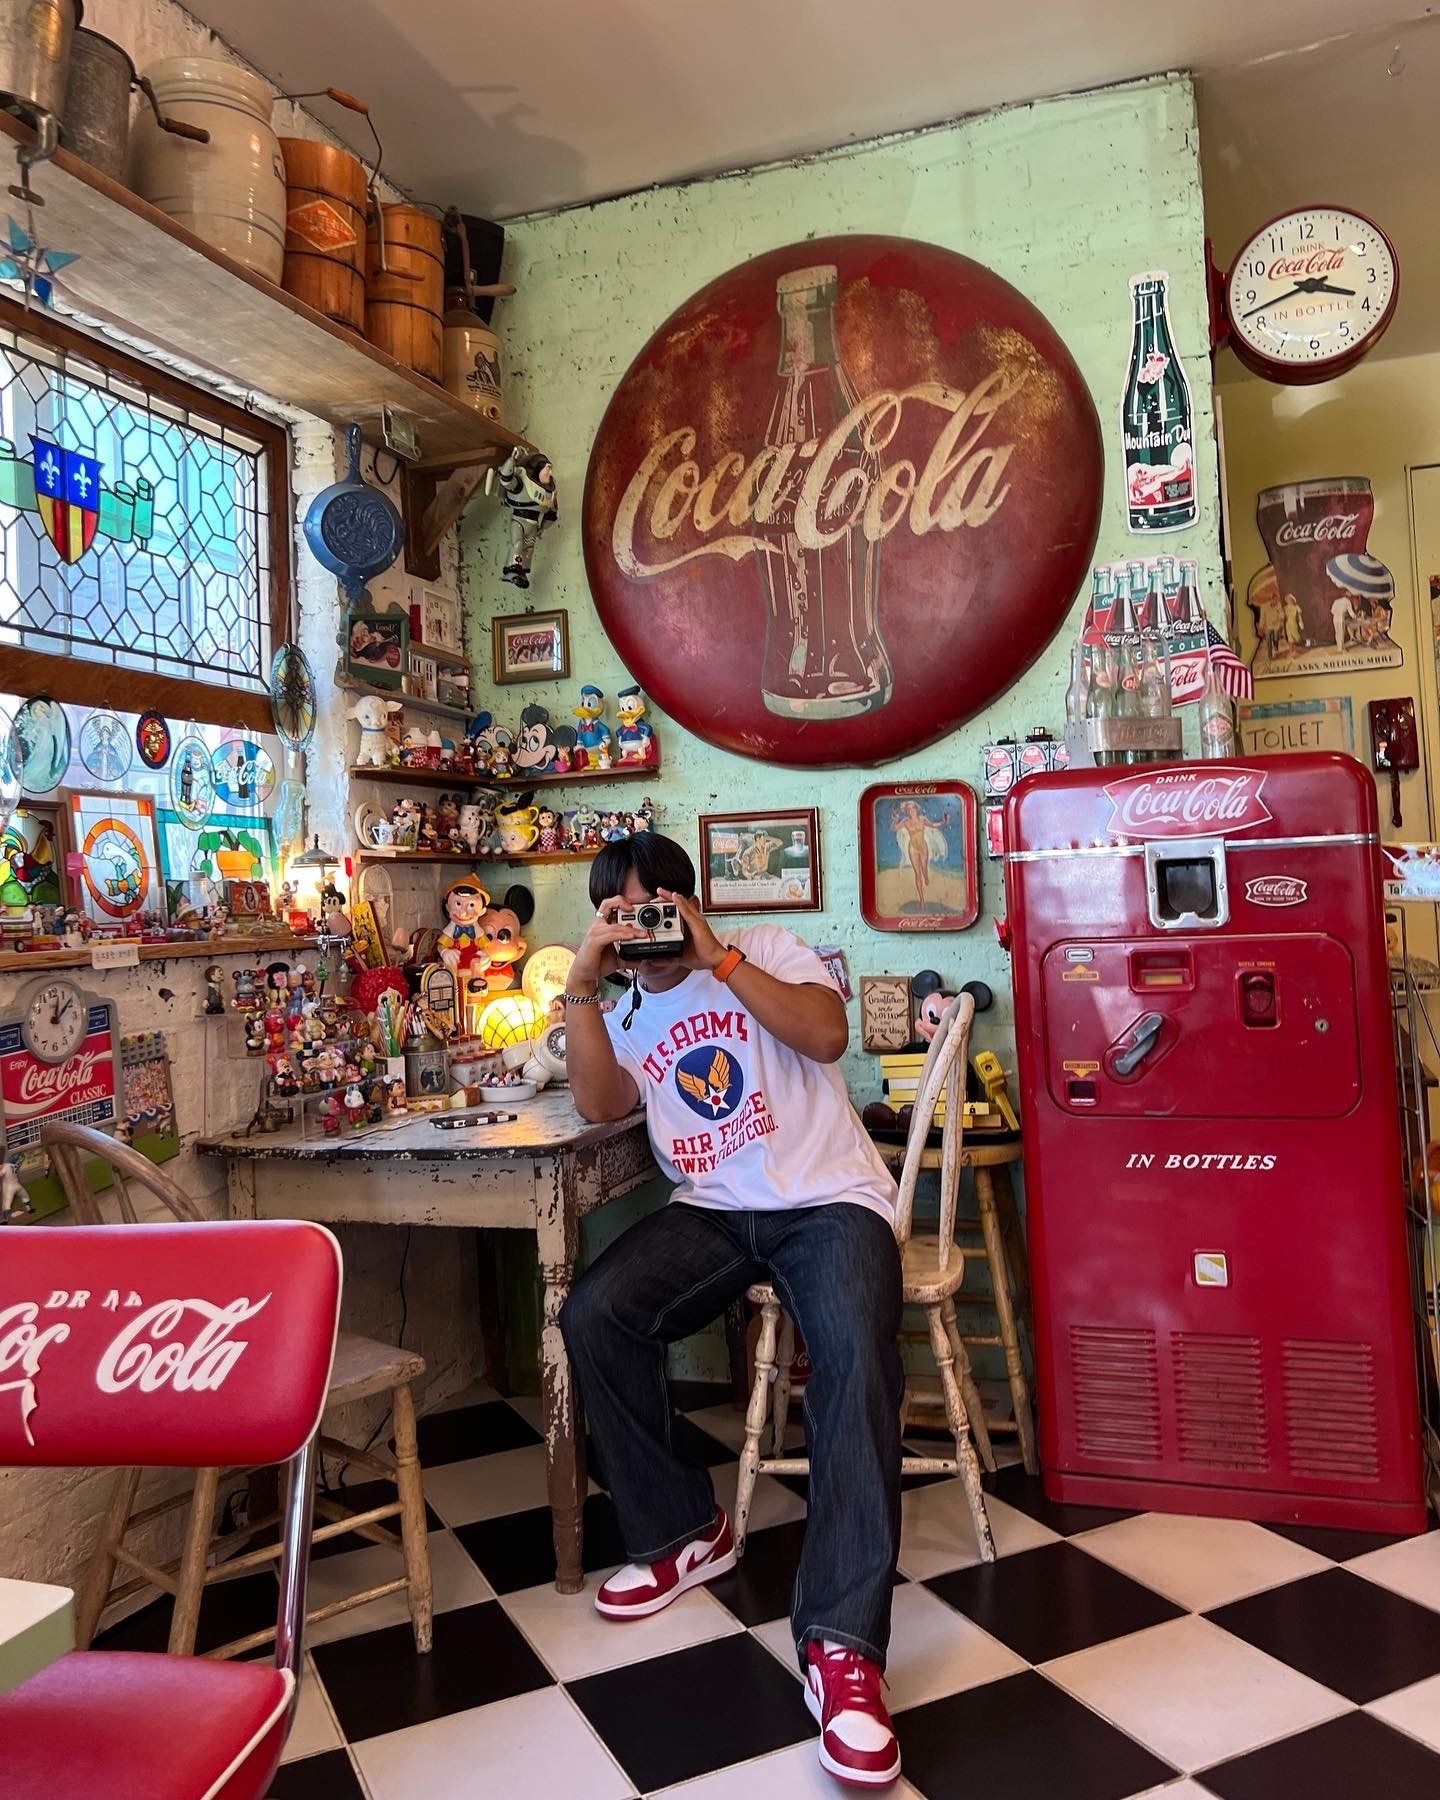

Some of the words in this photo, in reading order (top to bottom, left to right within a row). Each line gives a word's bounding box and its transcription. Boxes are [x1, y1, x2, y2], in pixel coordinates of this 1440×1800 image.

[1300, 223, 1314, 240] 12
[1335, 225, 1339, 240] 1
[1272, 236, 1284, 253] 11
[1292, 243, 1326, 256] DRINK
[1354, 241, 1366, 257] 2
[1249, 261, 1265, 277] 10
[1267, 246, 1350, 281] Coca-Cola
[1366, 267, 1377, 283] 3
[1246, 290, 1257, 304] 9
[1361, 297, 1370, 312] 4
[1274, 310, 1288, 320] IN
[1256, 316, 1266, 331] 8
[1339, 321, 1350, 337] 5
[1309, 336, 1320, 350] 6
[1124, 430, 1173, 450] Mountain
[612, 369, 1031, 579] Coca-Cola
[1275, 513, 1360, 547] Coca-Cola
[1168, 639, 1207, 654] COLD
[1246, 720, 1324, 752] TOILET
[1155, 773, 1198, 785] DRINK
[1121, 775, 1252, 826] Coca-Cola
[33, 1033, 40, 1043] 8
[42, 1040, 49, 1052] 7
[52, 1042, 59, 1052] 6
[9, 1060, 28, 1071] Enjoy
[21, 1050, 95, 1100] Coca-Cola
[70, 1083, 107, 1105] CLASSIC
[672, 1132, 713, 1156] AIR
[718, 1090, 767, 1145] FORCE
[672, 1154, 717, 1175] OWRY
[716, 1129, 746, 1164] FIELD
[1126, 1153, 1155, 1168] IN
[1164, 1153, 1277, 1170] BOTTLES
